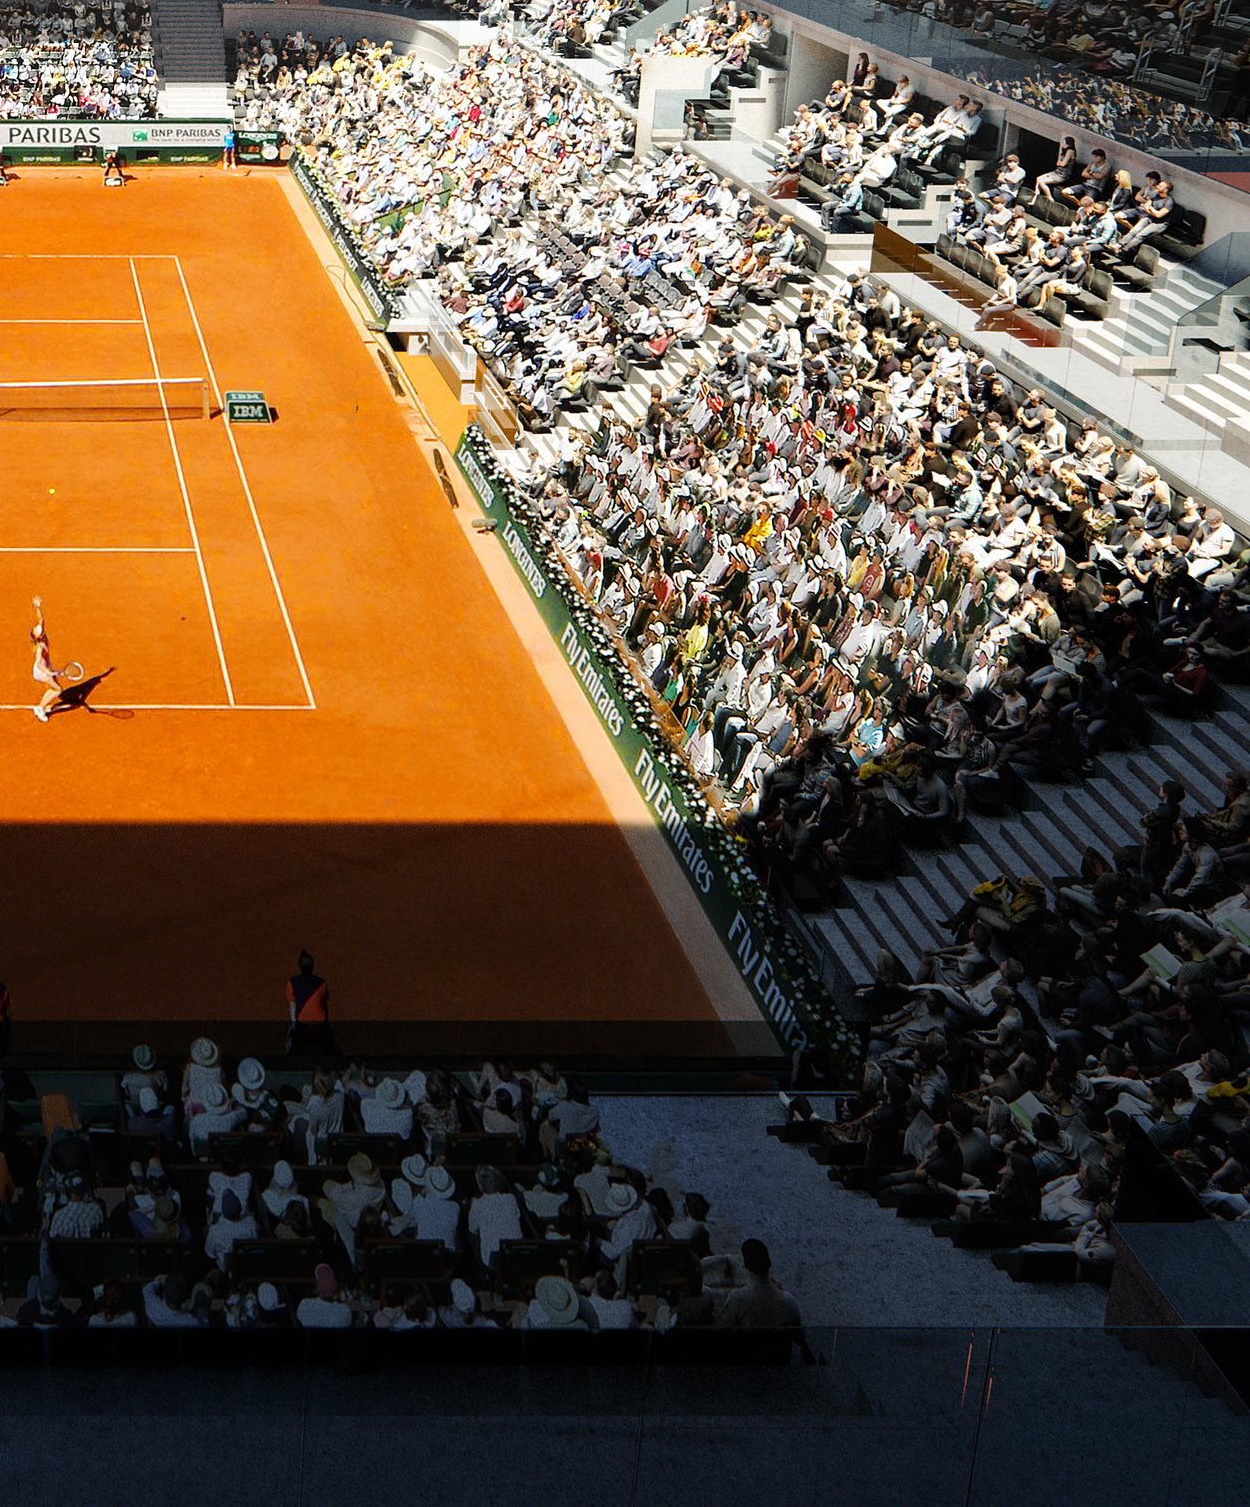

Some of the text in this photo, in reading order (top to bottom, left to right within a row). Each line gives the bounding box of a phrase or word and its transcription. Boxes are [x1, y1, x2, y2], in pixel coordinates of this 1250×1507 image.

[9, 127, 101, 143] PARIBAS
[151, 128, 221, 138] BNP PARIBAS
[233, 405, 264, 418] IBM
[503, 521, 546, 598] LONGINES
[561, 622, 625, 737] Fly Emirates
[634, 748, 715, 894] Fly Emirates
[727, 909, 809, 1053] Fly Emira
